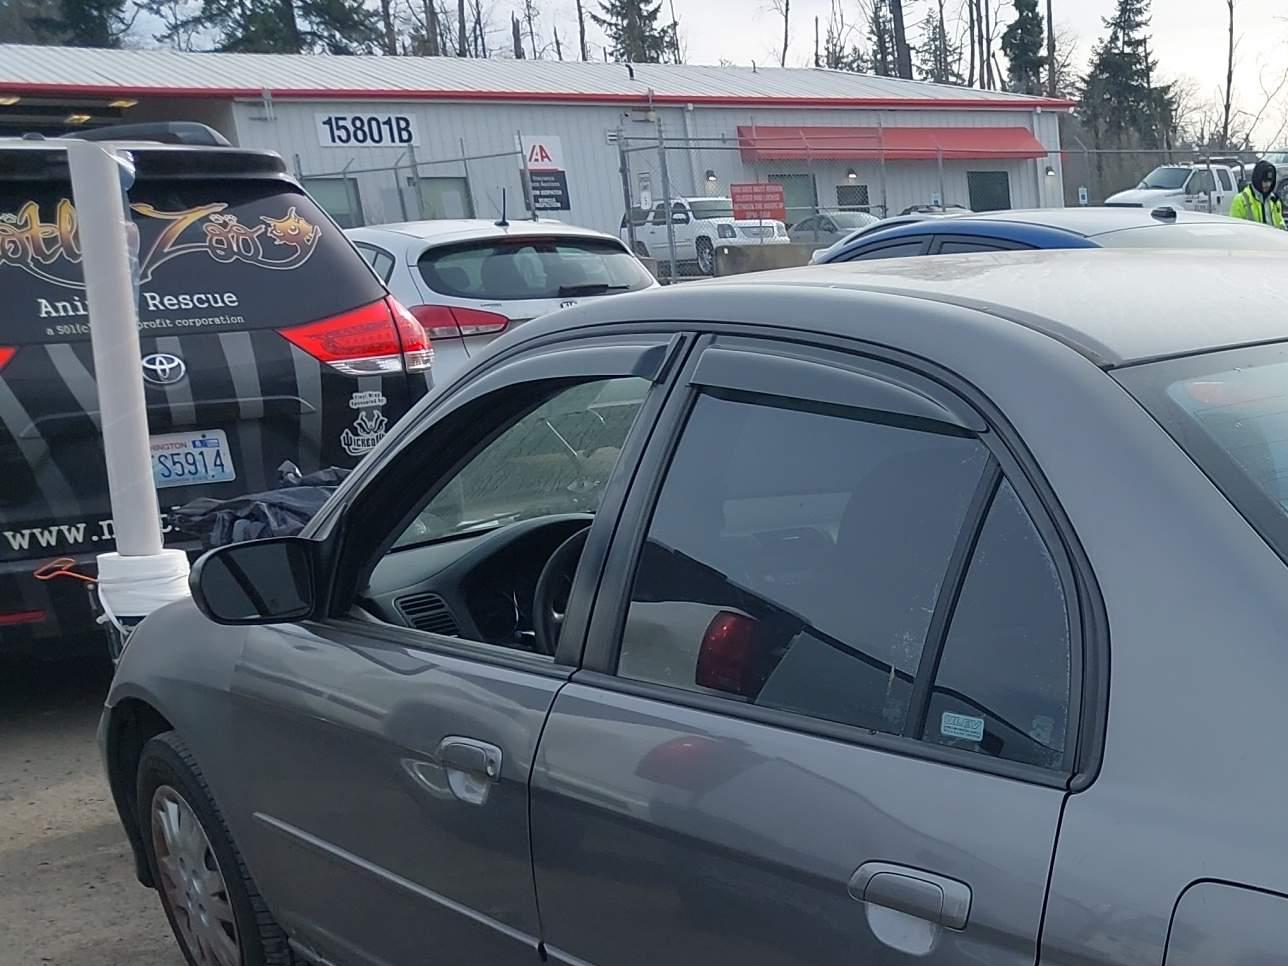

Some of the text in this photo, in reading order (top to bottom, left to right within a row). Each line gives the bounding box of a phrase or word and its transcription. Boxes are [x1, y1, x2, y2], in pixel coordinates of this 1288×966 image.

[322, 116, 413, 144] 15801B
[38, 292, 239, 318] Ani Rescue
[46, 328, 54, 336] a
[136, 319, 173, 330] profit
[175, 315, 244, 327] corporation
[157, 449, 225, 478] S5914
